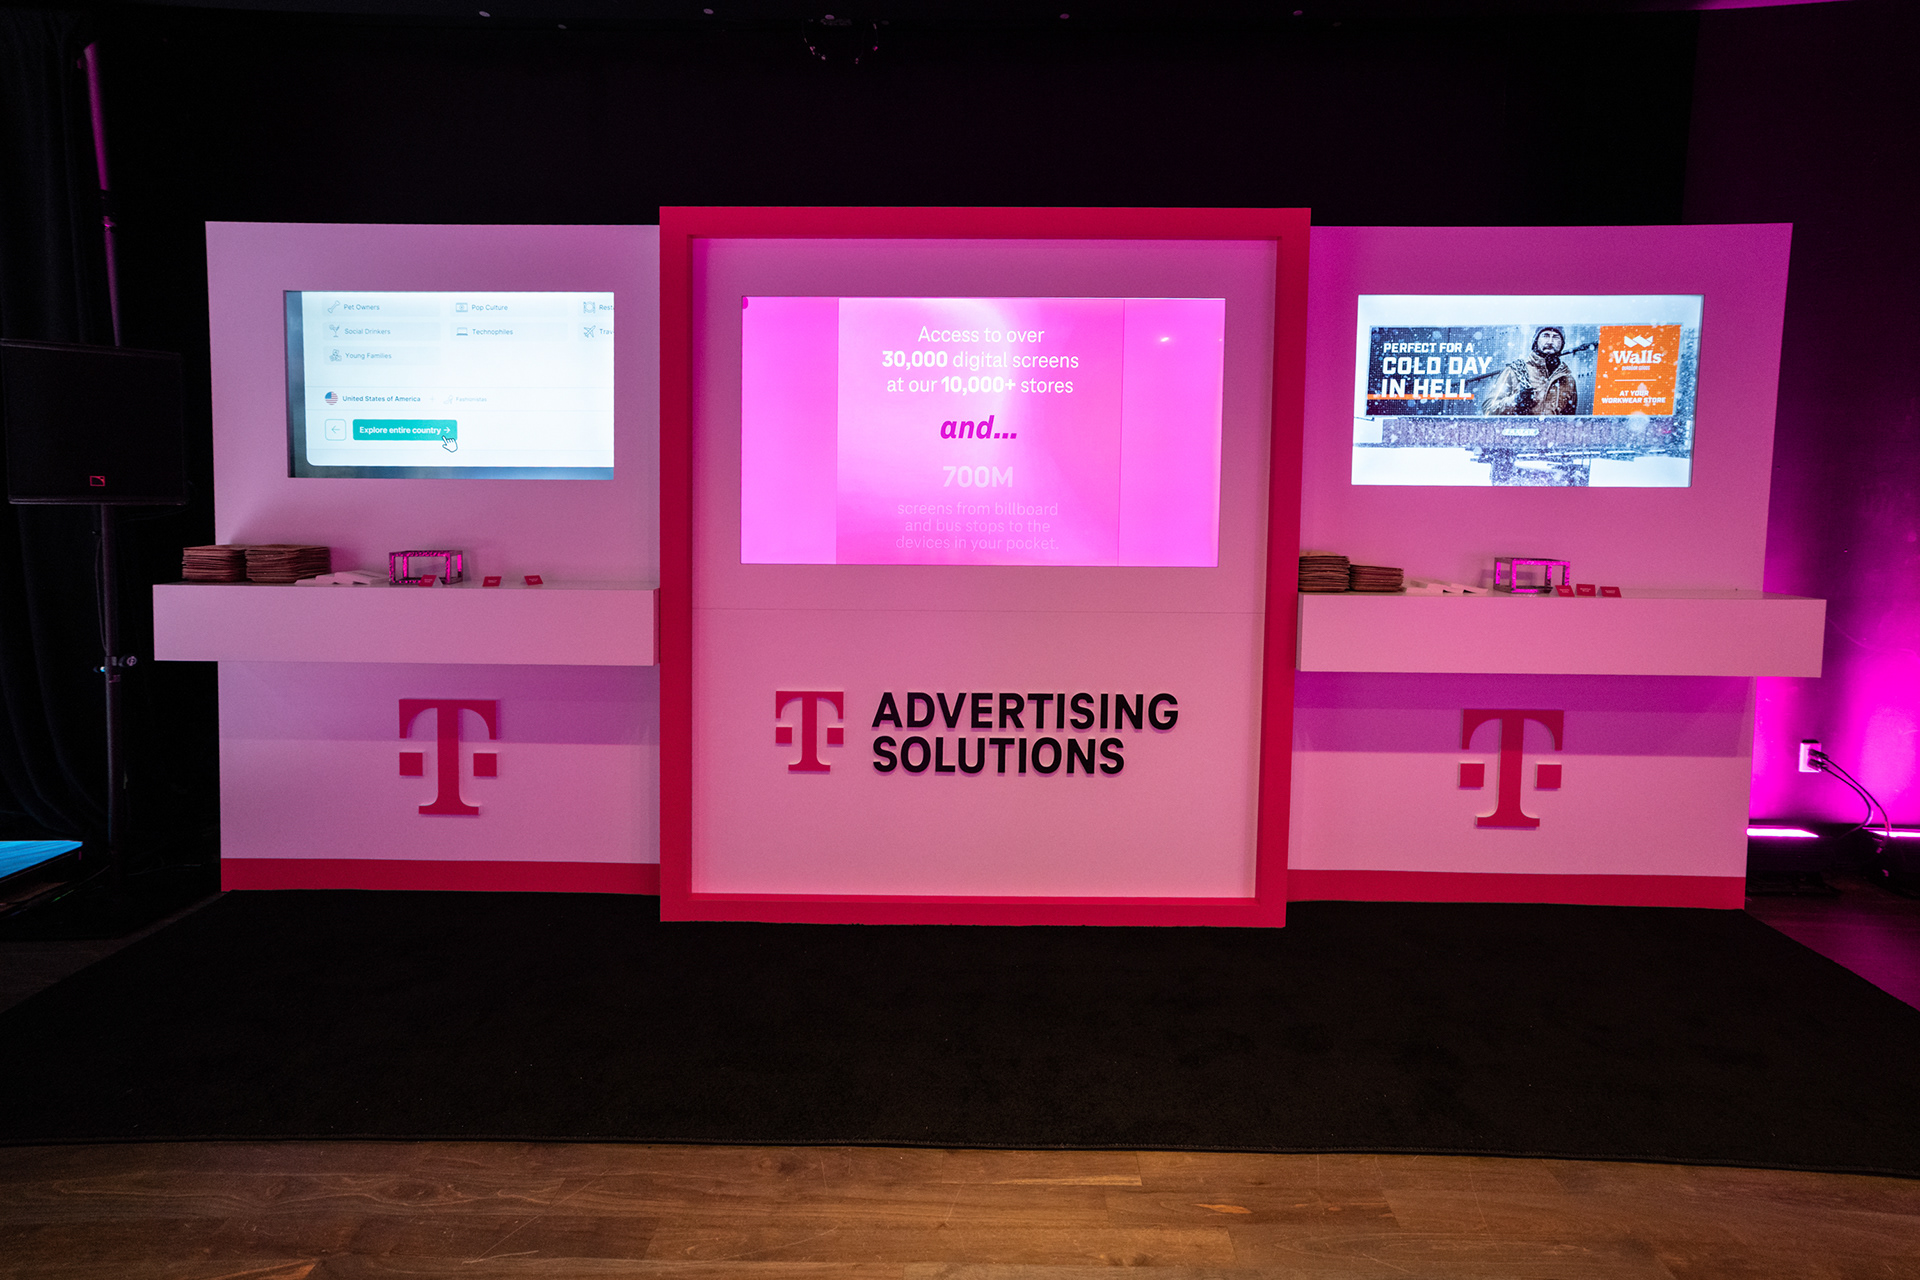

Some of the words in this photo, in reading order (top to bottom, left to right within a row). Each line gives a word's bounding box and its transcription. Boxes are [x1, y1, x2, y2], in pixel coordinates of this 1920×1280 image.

[343, 303, 354, 311] Pet
[356, 303, 380, 311] Owners
[471, 303, 484, 313] Pop
[486, 303, 508, 311] Culture
[344, 327, 363, 336] Social
[365, 327, 391, 336] Drinkers
[472, 328, 514, 337] Technophiles
[917, 325, 979, 343] Access
[984, 327, 1001, 343] to
[1006, 330, 1045, 343] over
[1383, 342, 1437, 353] PERFECT
[1439, 342, 1463, 353] FOR
[1465, 342, 1474, 353] A
[345, 352, 365, 362] Young
[366, 352, 392, 360] Families
[881, 350, 948, 371] 30,000
[952, 351, 1008, 372] digital
[1012, 355, 1079, 368] screens
[1612, 350, 1662, 364] Walls
[1382, 356, 1441, 375] COLD
[1448, 356, 1493, 375] DAY
[886, 377, 904, 393] at
[908, 379, 938, 393] our
[940, 375, 1016, 396] 10,000+
[1020, 378, 1074, 394] stores
[1381, 378, 1406, 398] IN
[1412, 378, 1472, 398] HELL
[359, 426, 388, 435] Explore
[388, 426, 411, 435] entire
[412, 427, 441, 436] country
[940, 414, 1018, 440] and...
[942, 465, 1014, 488] 700M
[897, 503, 953, 515] screens
[956, 501, 991, 515] from
[994, 502, 1058, 516] billboard
[905, 519, 932, 532] and
[936, 519, 962, 533] bus
[965, 521, 1005, 535] stops
[1008, 521, 1023, 533] to
[1027, 519, 1051, 533] the
[895, 536, 950, 549] devices
[954, 536, 967, 549] in
[970, 538, 1003, 552] your
[1006, 536, 1060, 552] pocket.
[871, 691, 1179, 731] ADVERTISING
[872, 735, 1125, 775] SOLUTIONS
